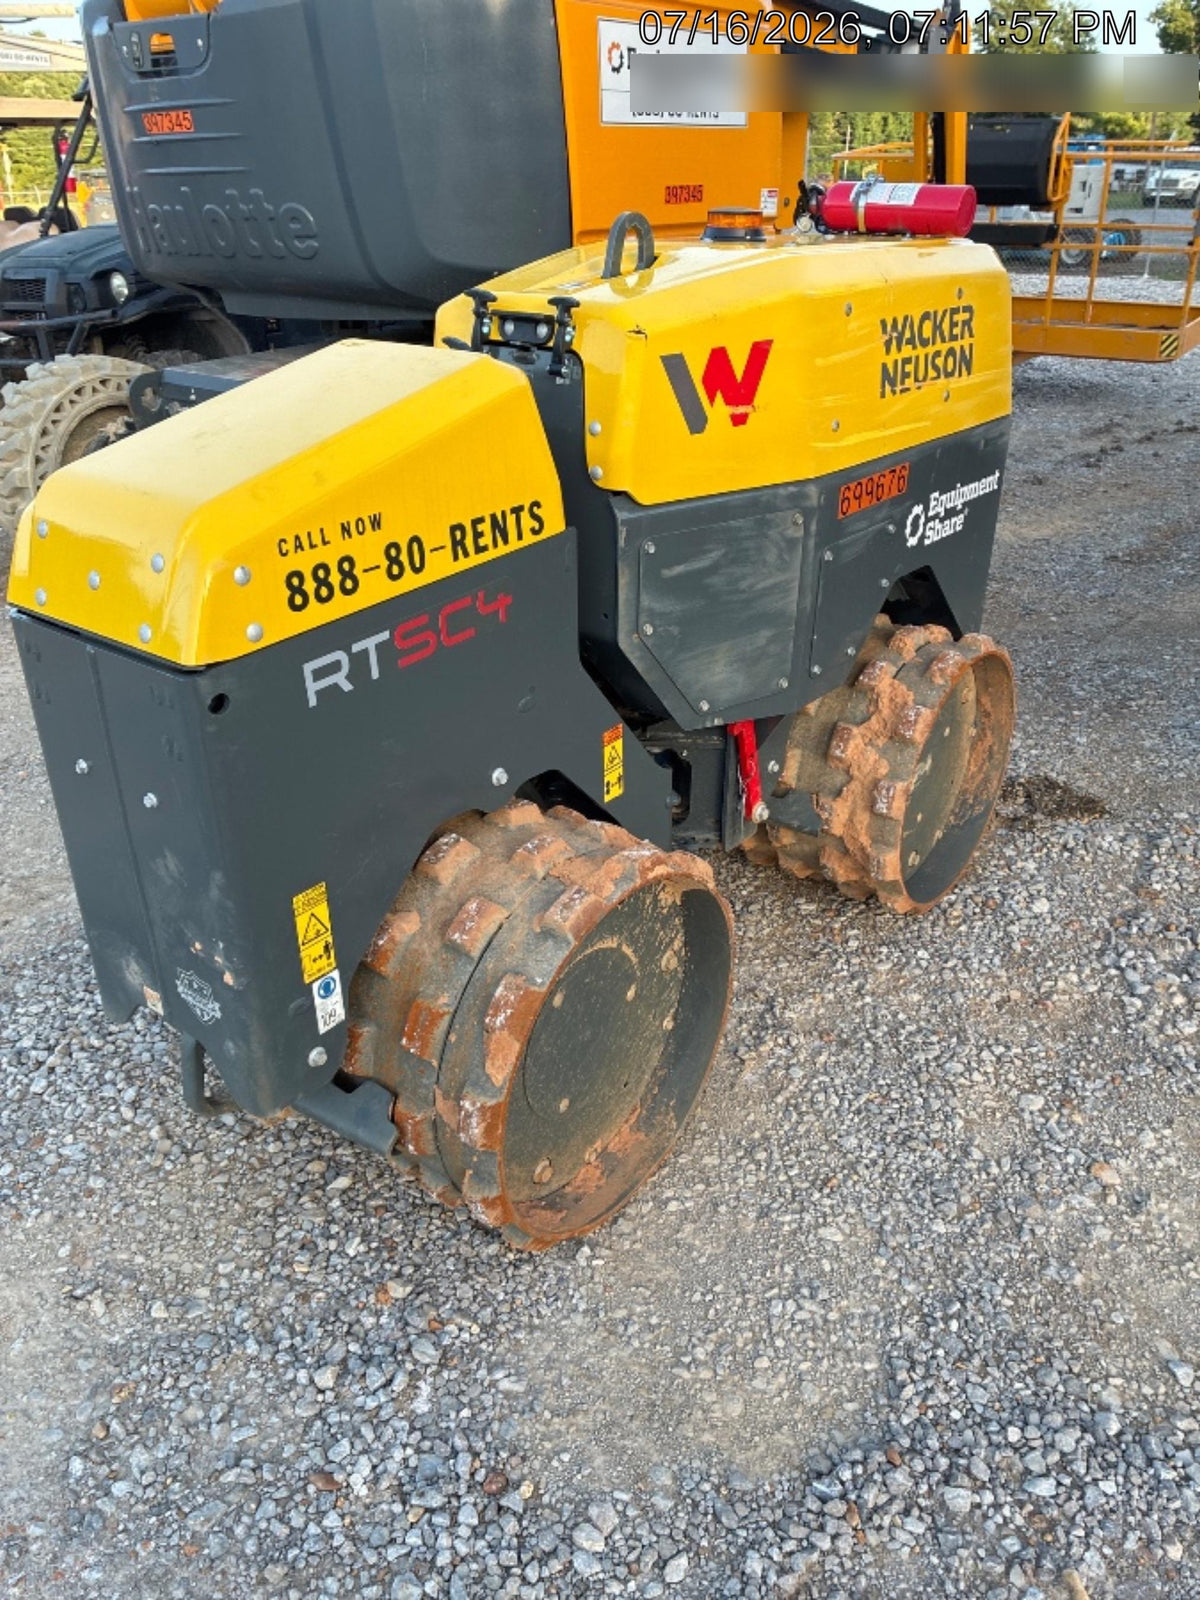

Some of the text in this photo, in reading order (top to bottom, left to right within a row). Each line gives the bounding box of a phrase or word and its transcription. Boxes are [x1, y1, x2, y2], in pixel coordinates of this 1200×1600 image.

[143, 111, 193, 132] 397345
[664, 184, 704, 204] 397345
[126, 186, 319, 260] Haulotte
[879, 304, 975, 356] WACKER
[879, 342, 974, 399] NEUSON
[840, 465, 908, 517] 699676
[928, 469, 1000, 518] Equipment
[277, 512, 383, 558] CALL NOW
[285, 500, 545, 613] 888-80-RENTS
[302, 589, 513, 708] RTSC4
